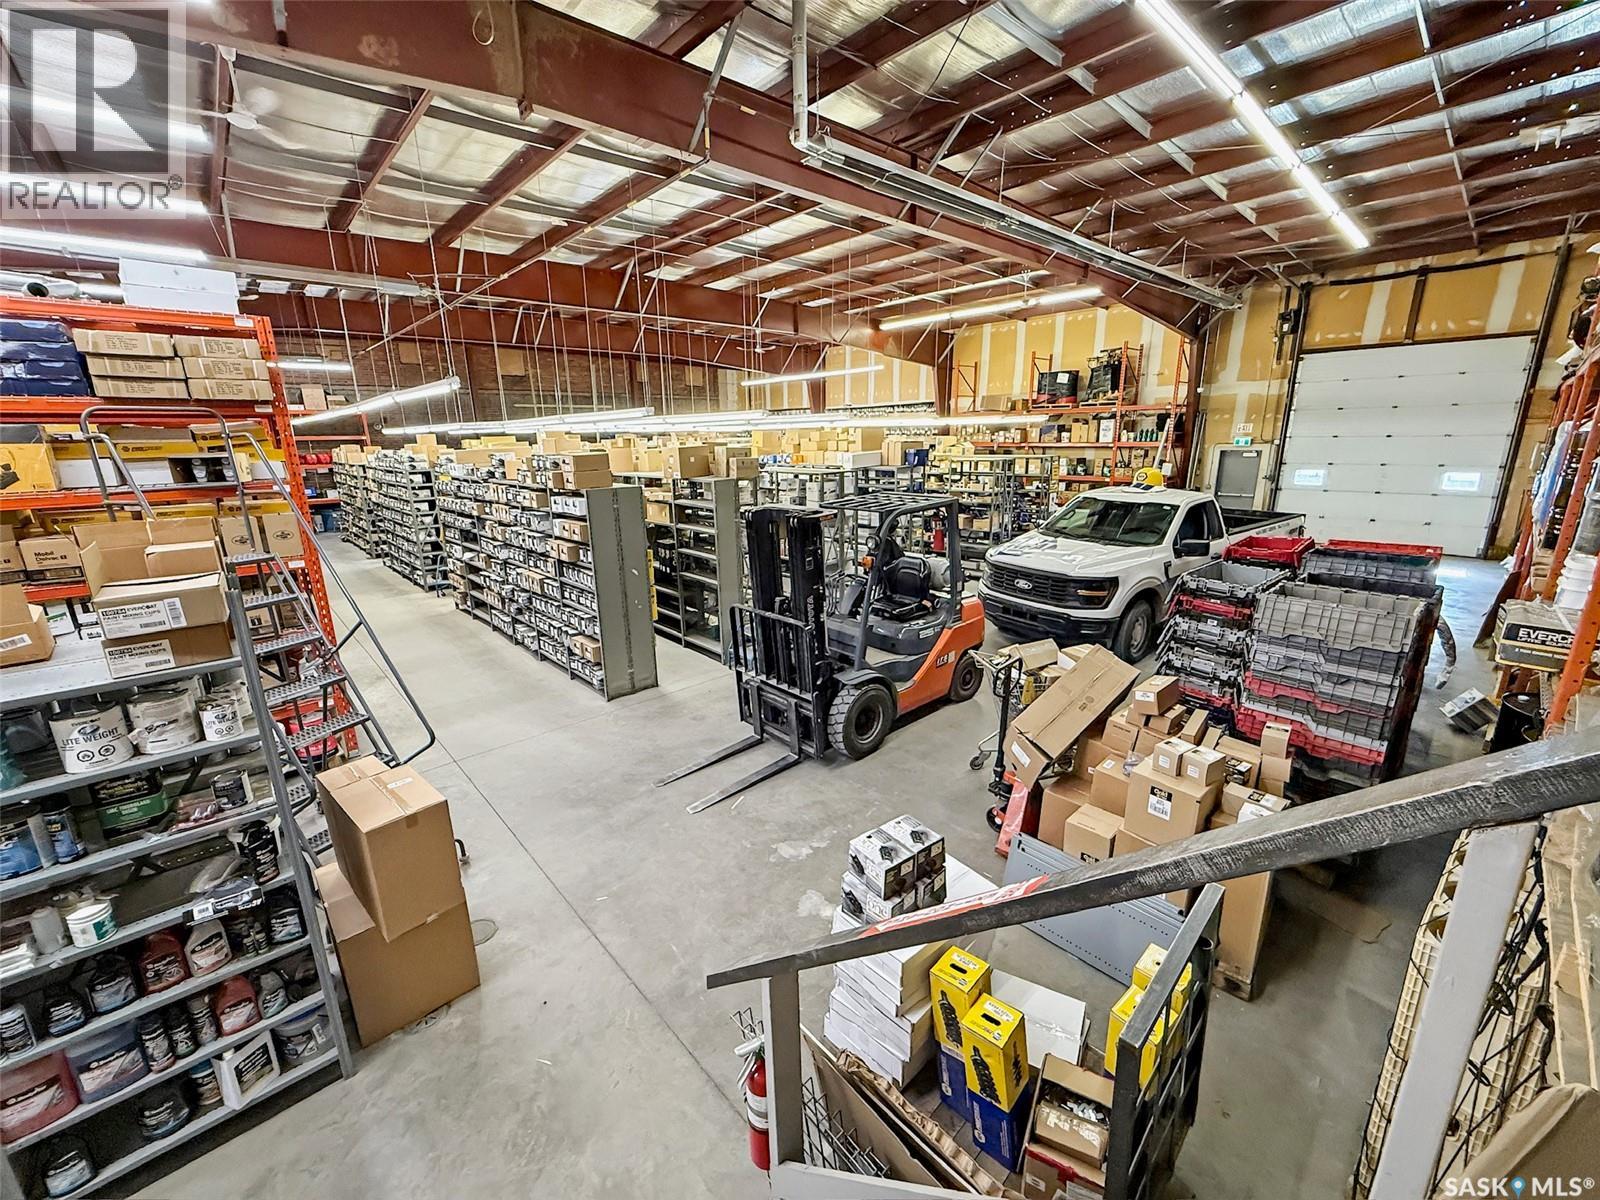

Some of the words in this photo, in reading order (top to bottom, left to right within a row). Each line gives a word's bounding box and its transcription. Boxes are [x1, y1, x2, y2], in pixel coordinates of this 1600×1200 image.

[127, 603, 157, 613] EVERCOAT
[62, 737, 81, 746] LITE
[83, 727, 119, 743] WEIGHT
